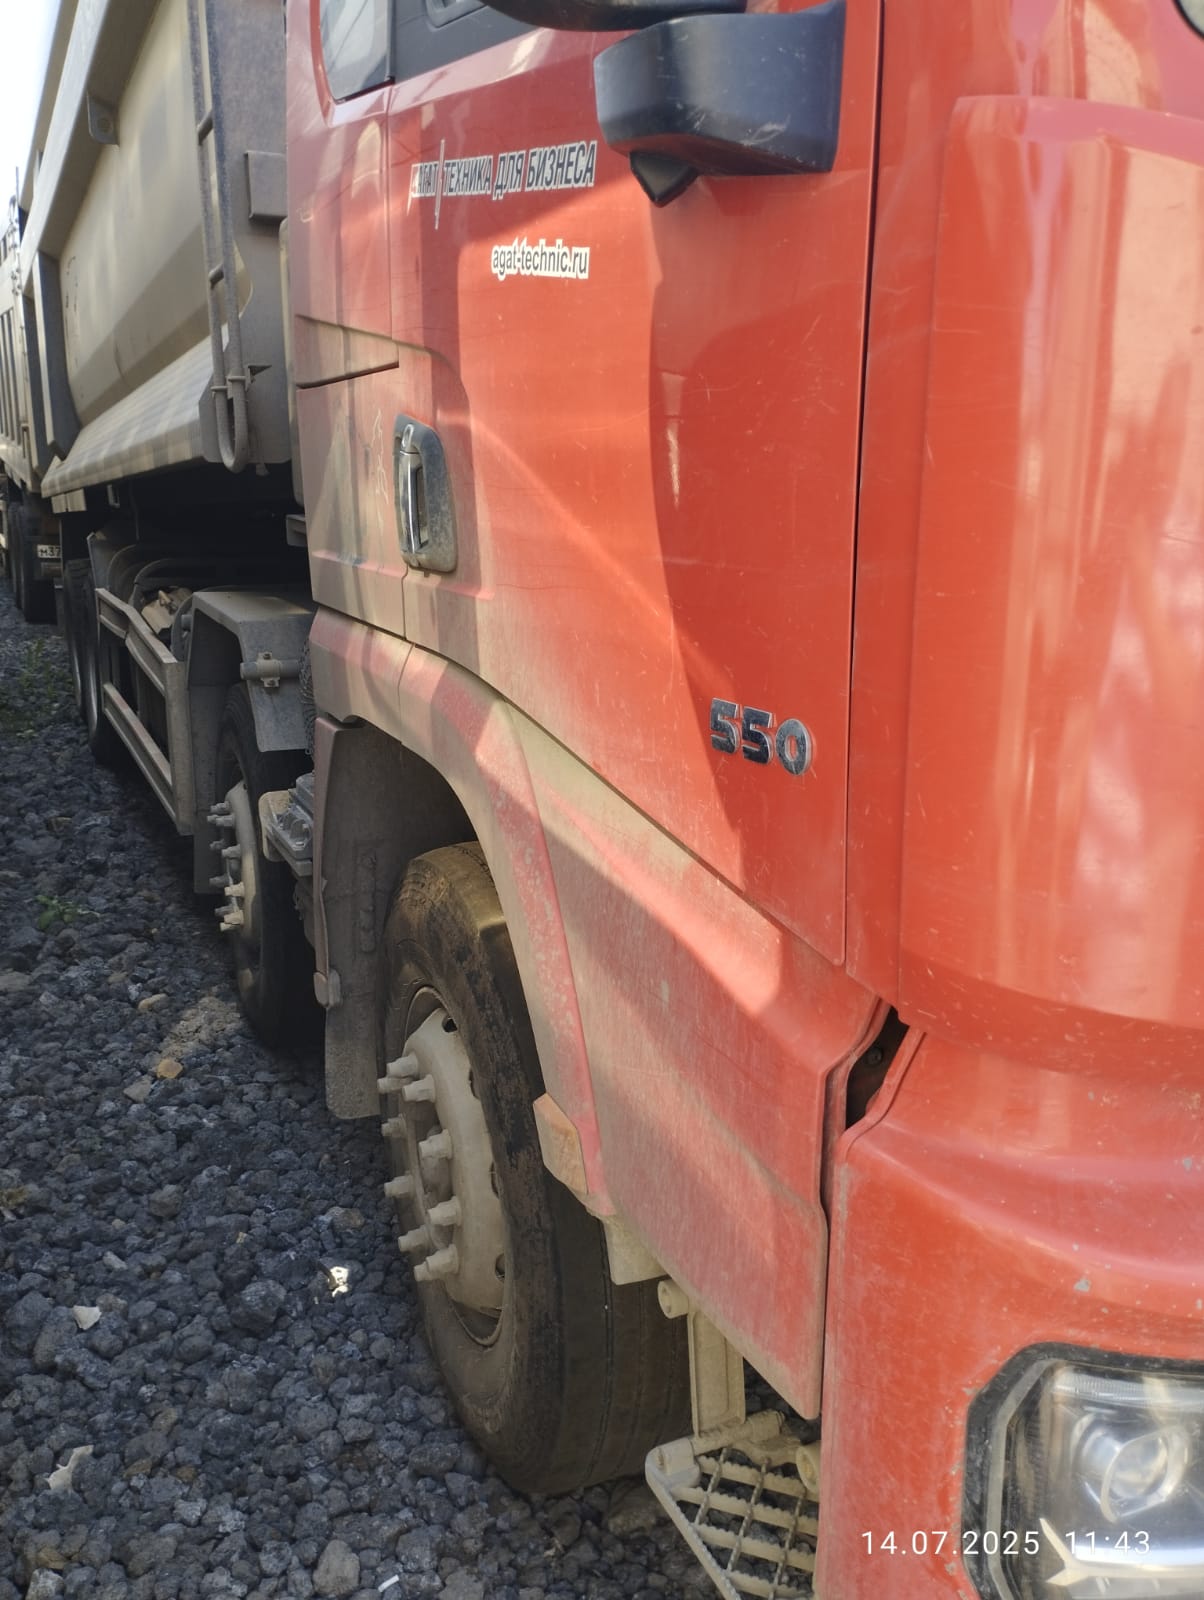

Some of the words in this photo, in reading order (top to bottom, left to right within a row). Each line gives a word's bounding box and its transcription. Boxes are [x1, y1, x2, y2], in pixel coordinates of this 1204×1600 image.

[443, 157, 492, 194] ТЕХНИКА
[494, 154, 525, 198] ДЛЯ
[527, 143, 596, 188] БИЗНЕСА
[492, 240, 588, 276] agat-technic.ru
[710, 697, 812, 775] 550
